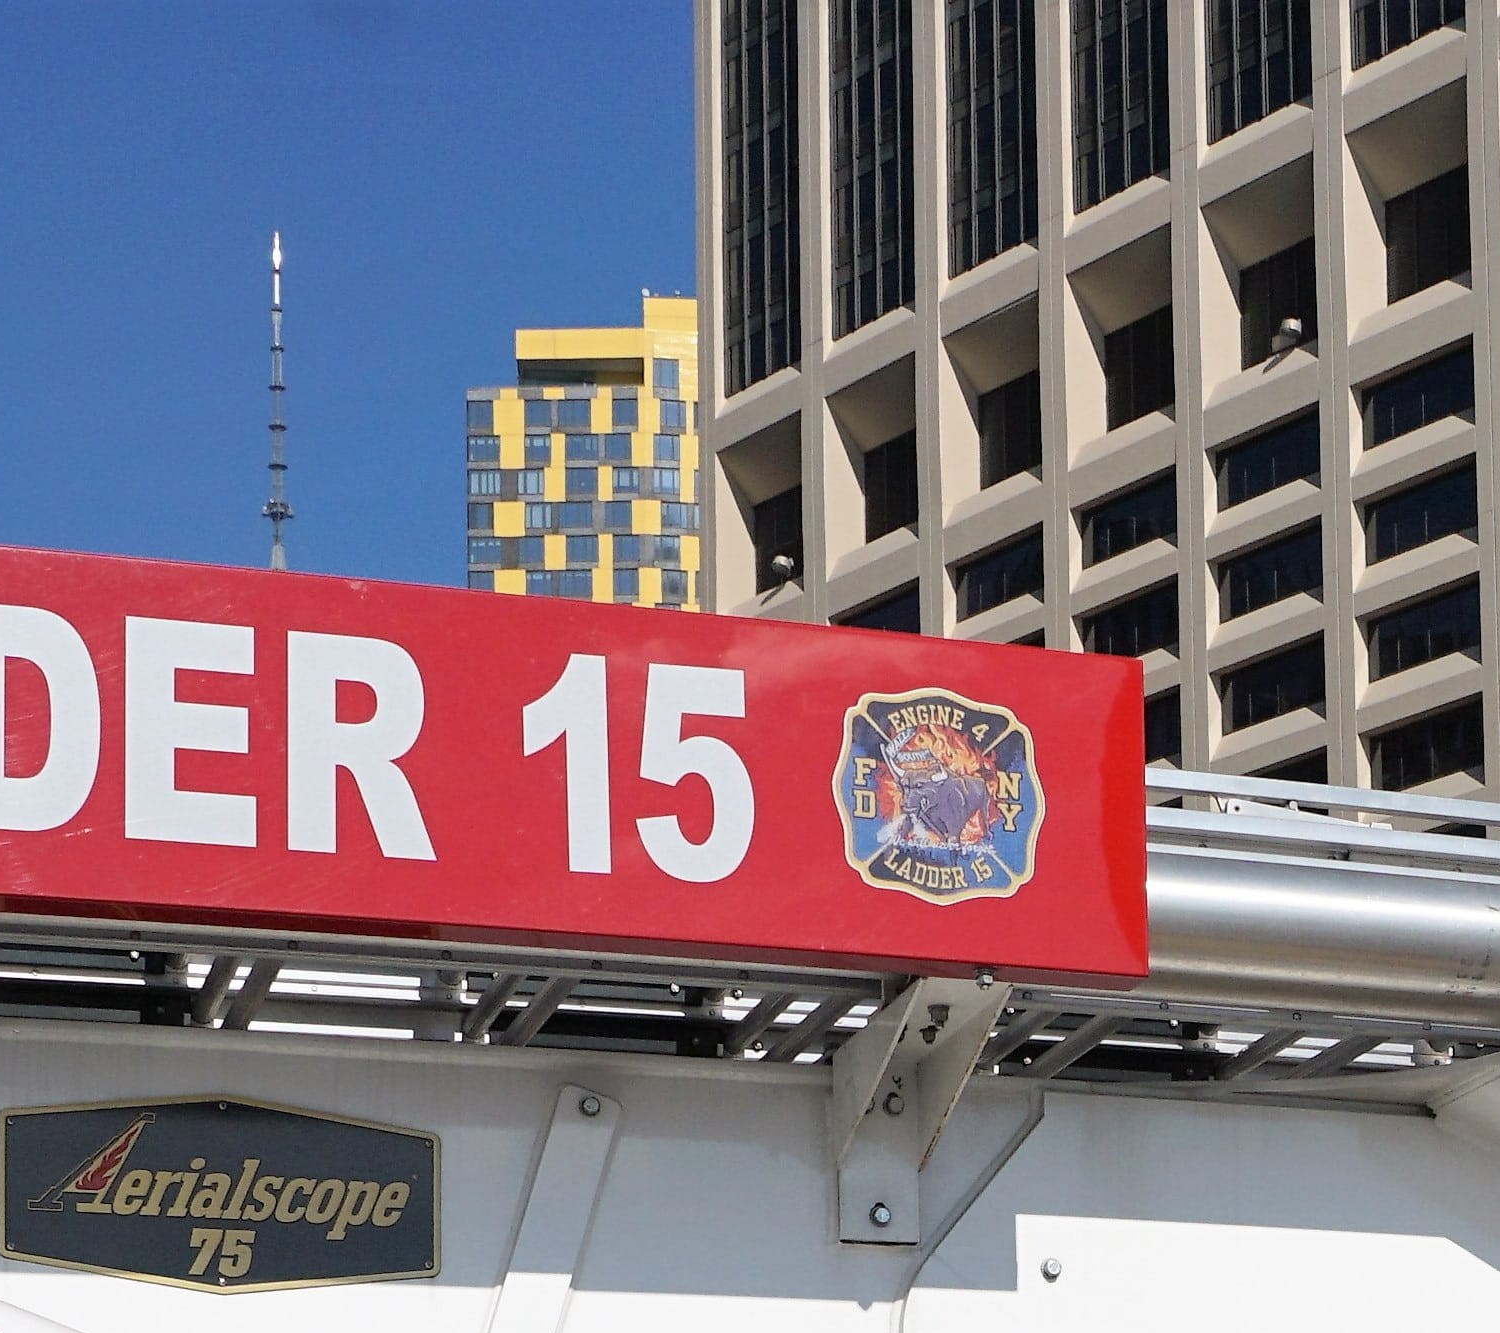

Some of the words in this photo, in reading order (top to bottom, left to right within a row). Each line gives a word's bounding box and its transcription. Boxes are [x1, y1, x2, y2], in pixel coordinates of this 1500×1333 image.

[887, 704, 966, 732] ENGINE
[971, 722, 990, 743] 4
[521, 652, 756, 884] 15
[884, 848, 968, 890] LADDER
[971, 857, 993, 883] 15
[27, 1112, 412, 1240] Aerialscope
[188, 1228, 256, 1278] 75
